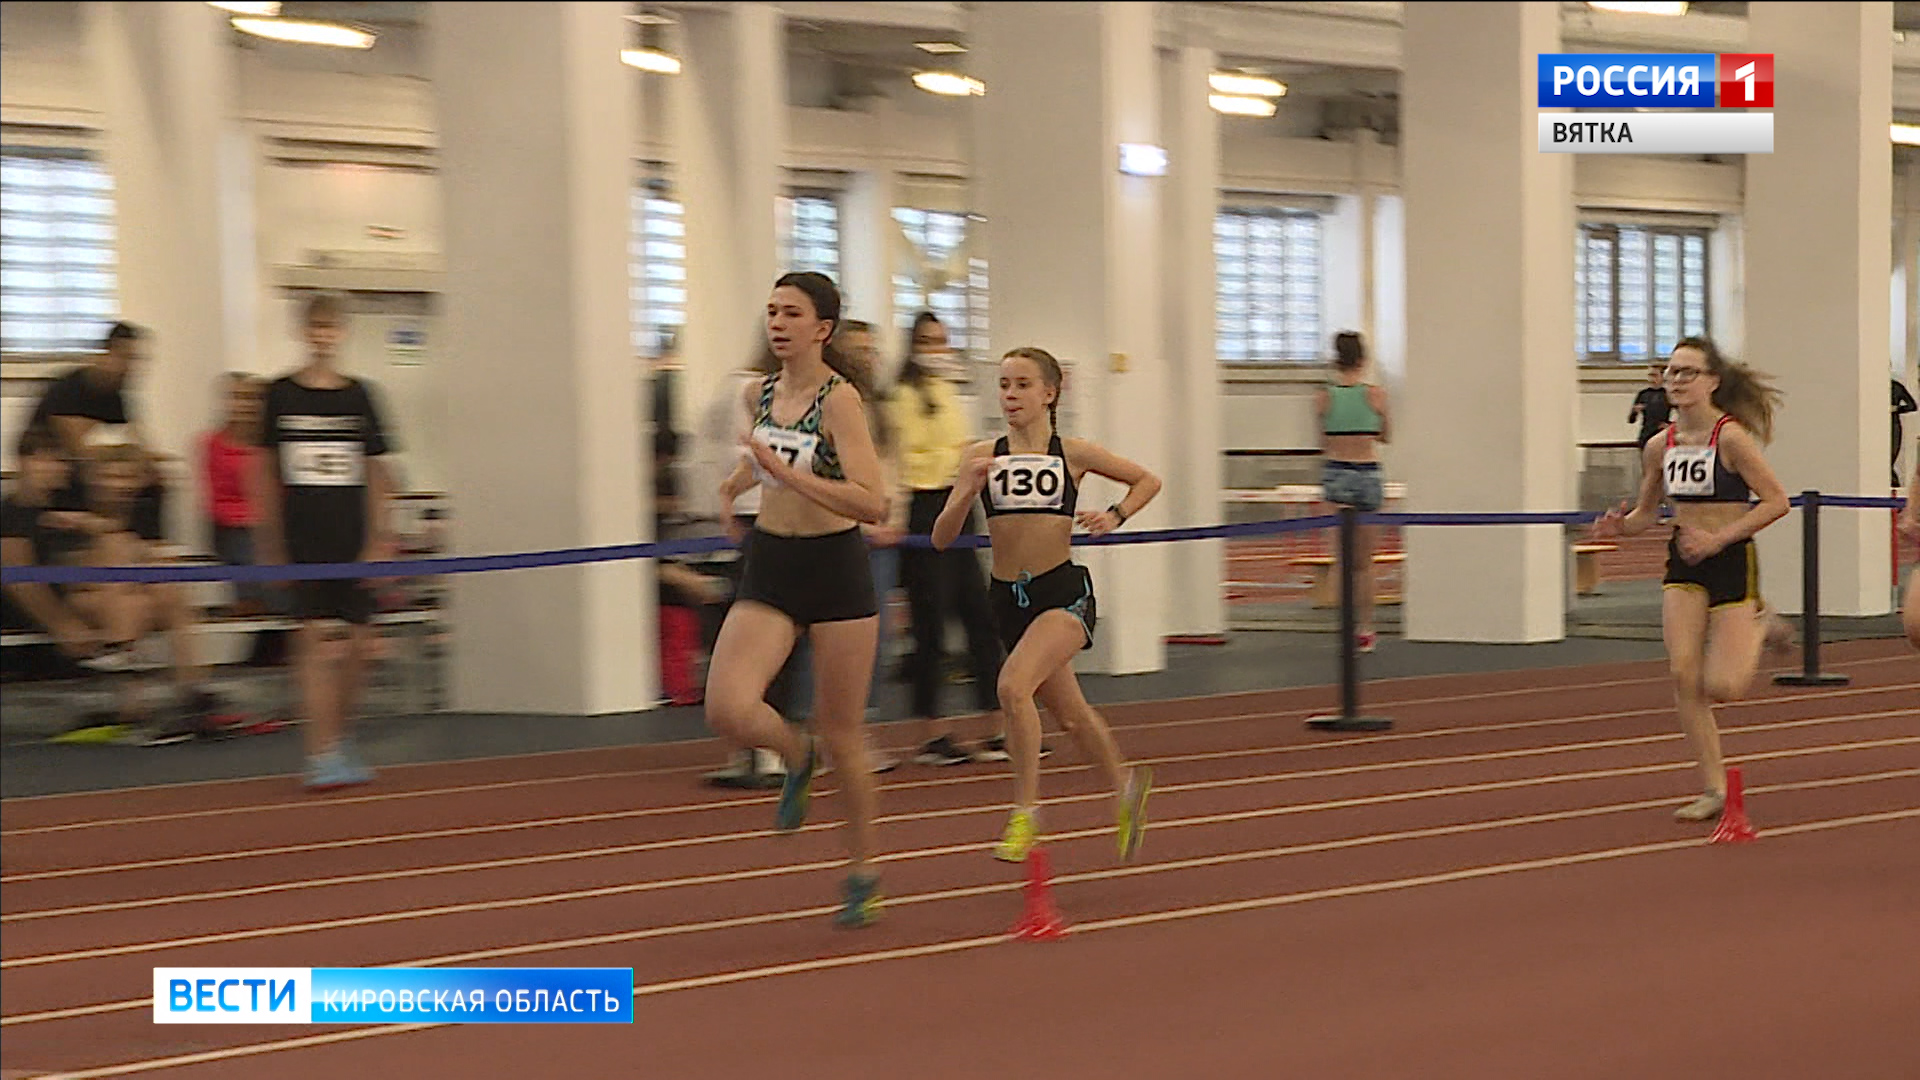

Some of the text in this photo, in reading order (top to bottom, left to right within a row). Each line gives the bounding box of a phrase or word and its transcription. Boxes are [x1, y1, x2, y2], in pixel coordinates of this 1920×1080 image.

[768, 444, 800, 468] 7
[993, 469, 1059, 496] 130
[1667, 459, 1706, 483] 116
